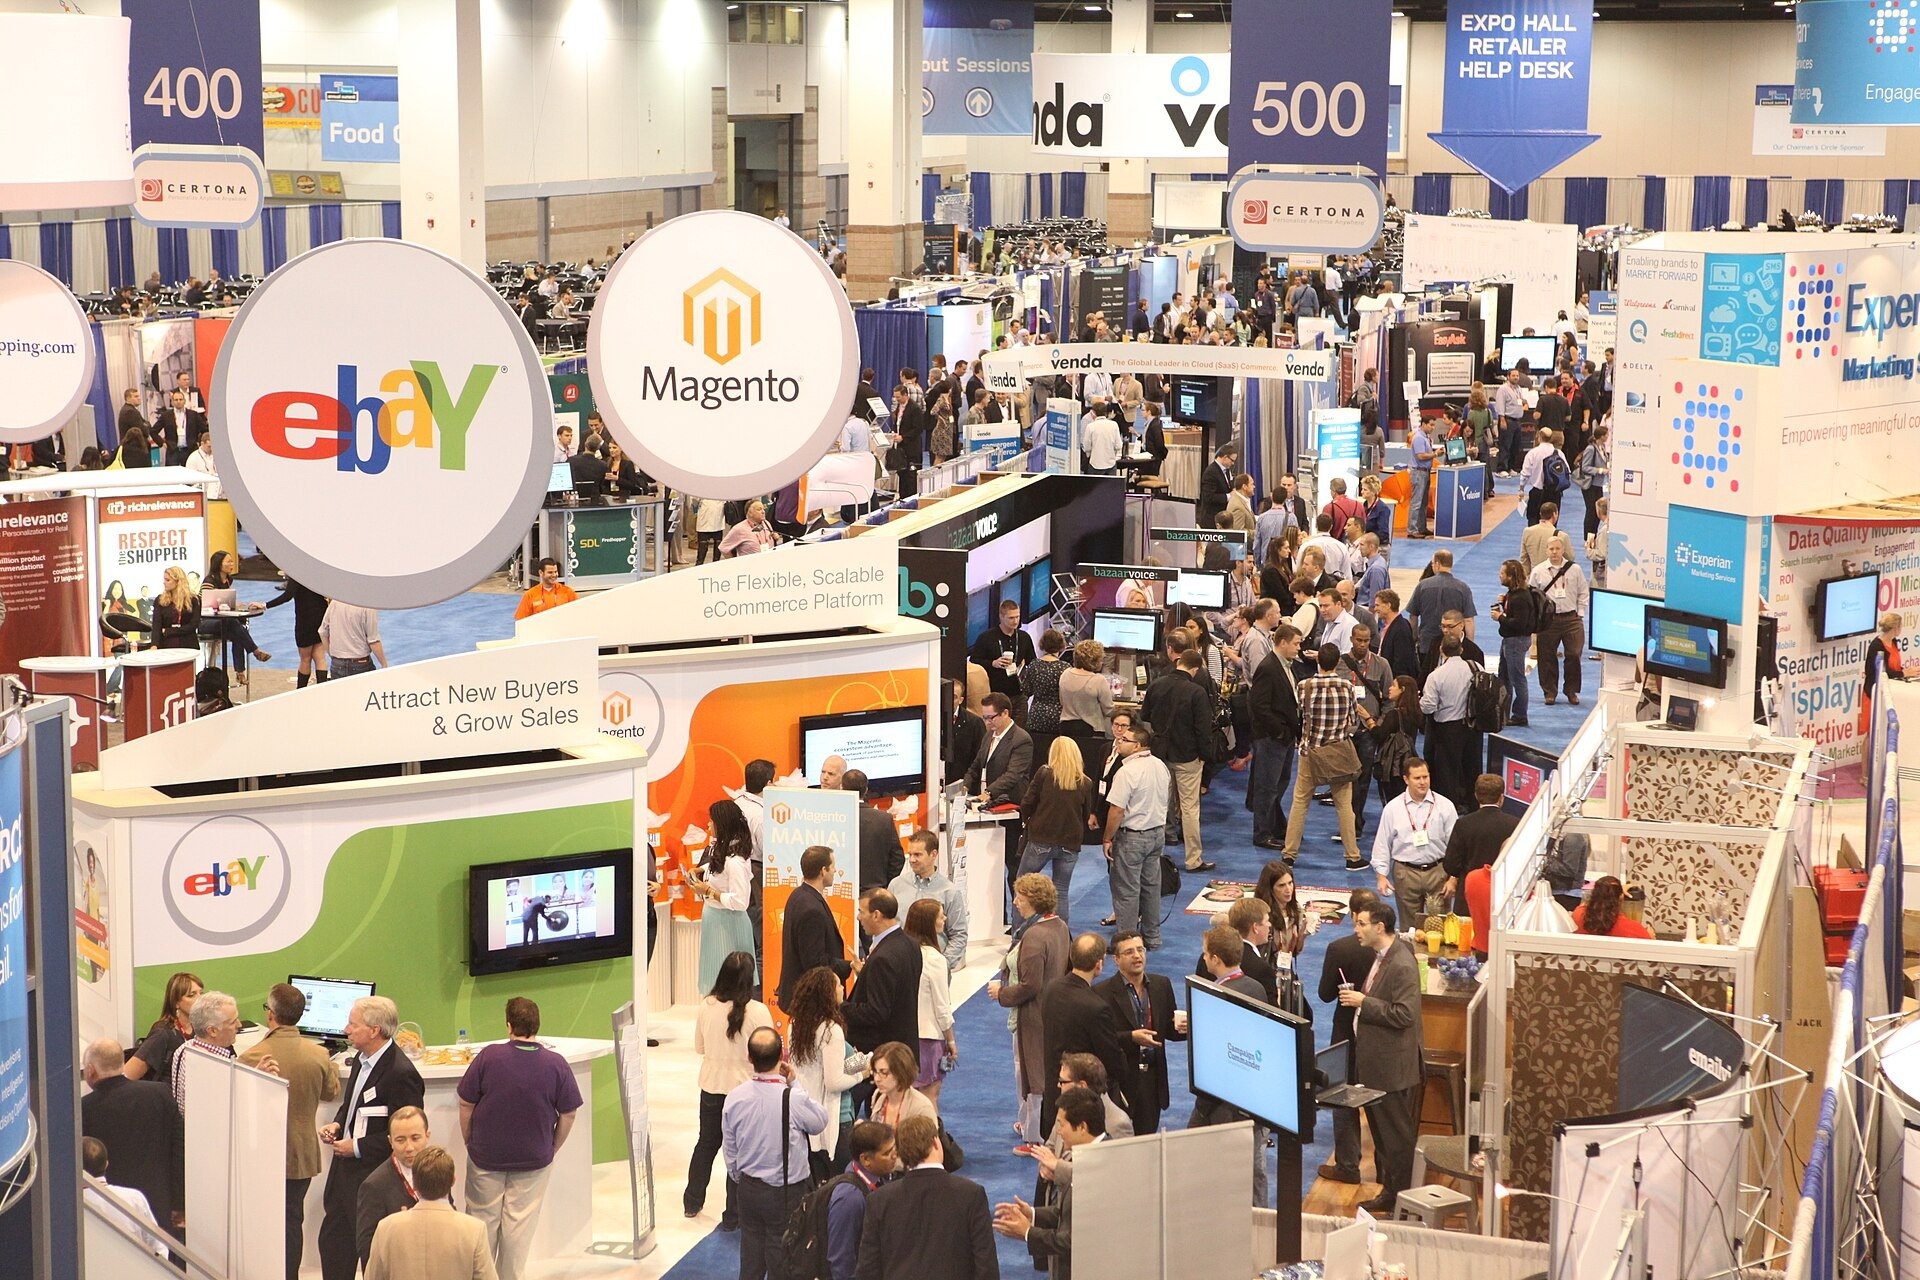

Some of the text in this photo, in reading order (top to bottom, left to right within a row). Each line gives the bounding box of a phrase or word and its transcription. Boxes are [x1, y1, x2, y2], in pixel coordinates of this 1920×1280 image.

[1461, 14, 1577, 32] EXPO HALL
[1469, 38, 1566, 56] RETAILER
[957, 56, 1030, 73] Sessions
[1459, 61, 1574, 79] HELP DESK
[144, 67, 242, 119] 400
[1252, 81, 1366, 137] 500
[330, 122, 384, 144] Food
[167, 184, 247, 194] CERTONA
[1272, 205, 1365, 218] CERTONA
[1626, 255, 1698, 269] Enabling brands to
[1765, 262, 1781, 271] SMS
[1625, 269, 1698, 282] MARKET FORWARD
[1669, 304, 1696, 312] Carnival
[1051, 354, 1103, 369] venda
[1127, 359, 1151, 367] Global
[1154, 360, 1180, 368] Leader
[1215, 361, 1239, 370] (SaaS)
[1240, 363, 1278, 372] Commerce.
[1285, 364, 1324, 376] venda
[1629, 362, 1654, 371] DELTA
[1843, 354, 1914, 381] Marketing
[642, 366, 800, 410] Magento
[989, 372, 1017, 388] venda
[1782, 422, 1848, 446] Empowering
[1850, 413, 1906, 435] meaningful
[128, 501, 195, 512] richrelevance
[2, 529, 46, 537] Personalization
[119, 530, 186, 549] RESPECT
[1789, 529, 1820, 551] Data
[1822, 526, 1868, 547] Quality
[580, 539, 600, 548] SDL
[1875, 540, 1915, 557] Engagement
[20, 555, 45, 563] product
[127, 547, 187, 564] SHOPPER
[1651, 553, 1665, 565] Tap
[1692, 551, 1731, 569] Experian
[1780, 553, 1833, 568] Search Intelligence
[698, 566, 884, 594] The Flexible, Scalable
[1691, 569, 1736, 583] Marketing Services
[1780, 574, 1794, 585] ROI
[703, 592, 883, 618] eCommerce Platform
[1776, 594, 1789, 602] Data
[1779, 647, 1829, 676] Search
[365, 678, 578, 712] Attract New Buyers
[432, 706, 579, 735] & Grow Sales
[794, 807, 847, 824] Magento
[772, 827, 846, 848] MANIA!
[1797, 1019, 1822, 1027] JACK
[1227, 1042, 1255, 1061] Campaign
[1227, 1050, 1261, 1071] Commander
